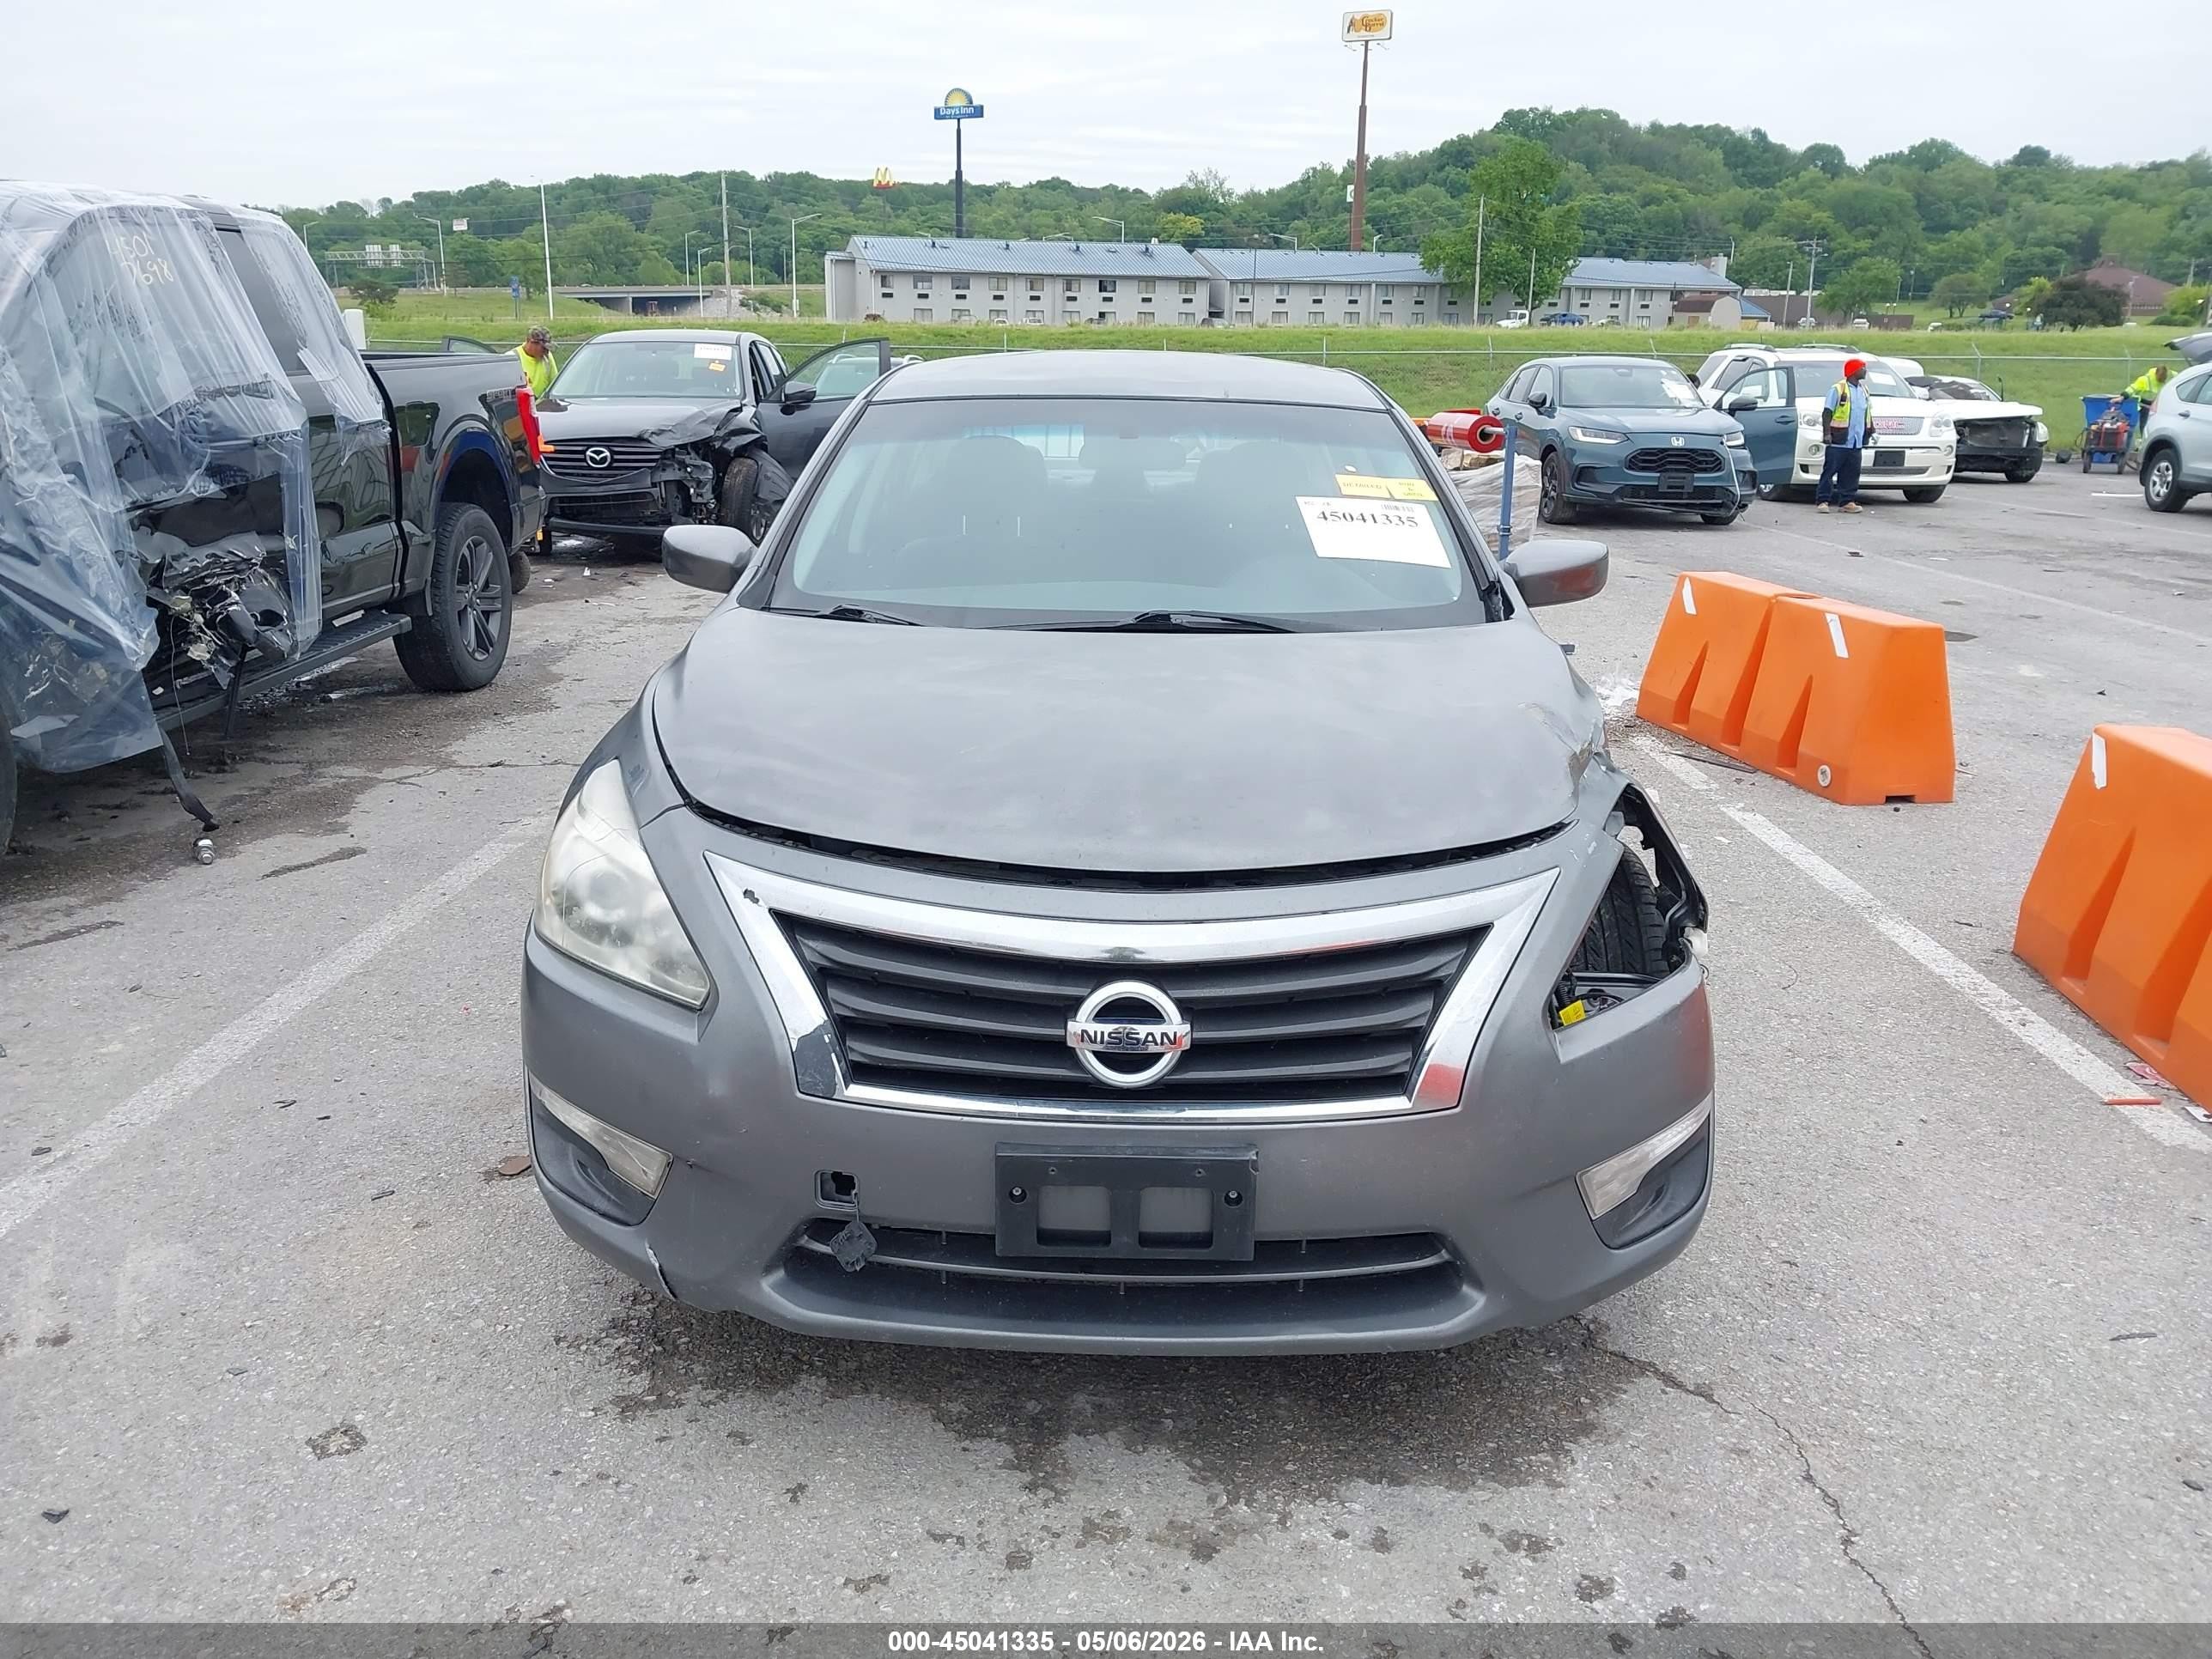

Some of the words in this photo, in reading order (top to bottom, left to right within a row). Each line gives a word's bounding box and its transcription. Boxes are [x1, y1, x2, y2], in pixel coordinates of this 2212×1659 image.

[939, 106, 959, 116] Days
[960, 106, 975, 114] Inn
[1316, 510, 1419, 528] 45041335
[1080, 1029, 1177, 1047] NISSAN
